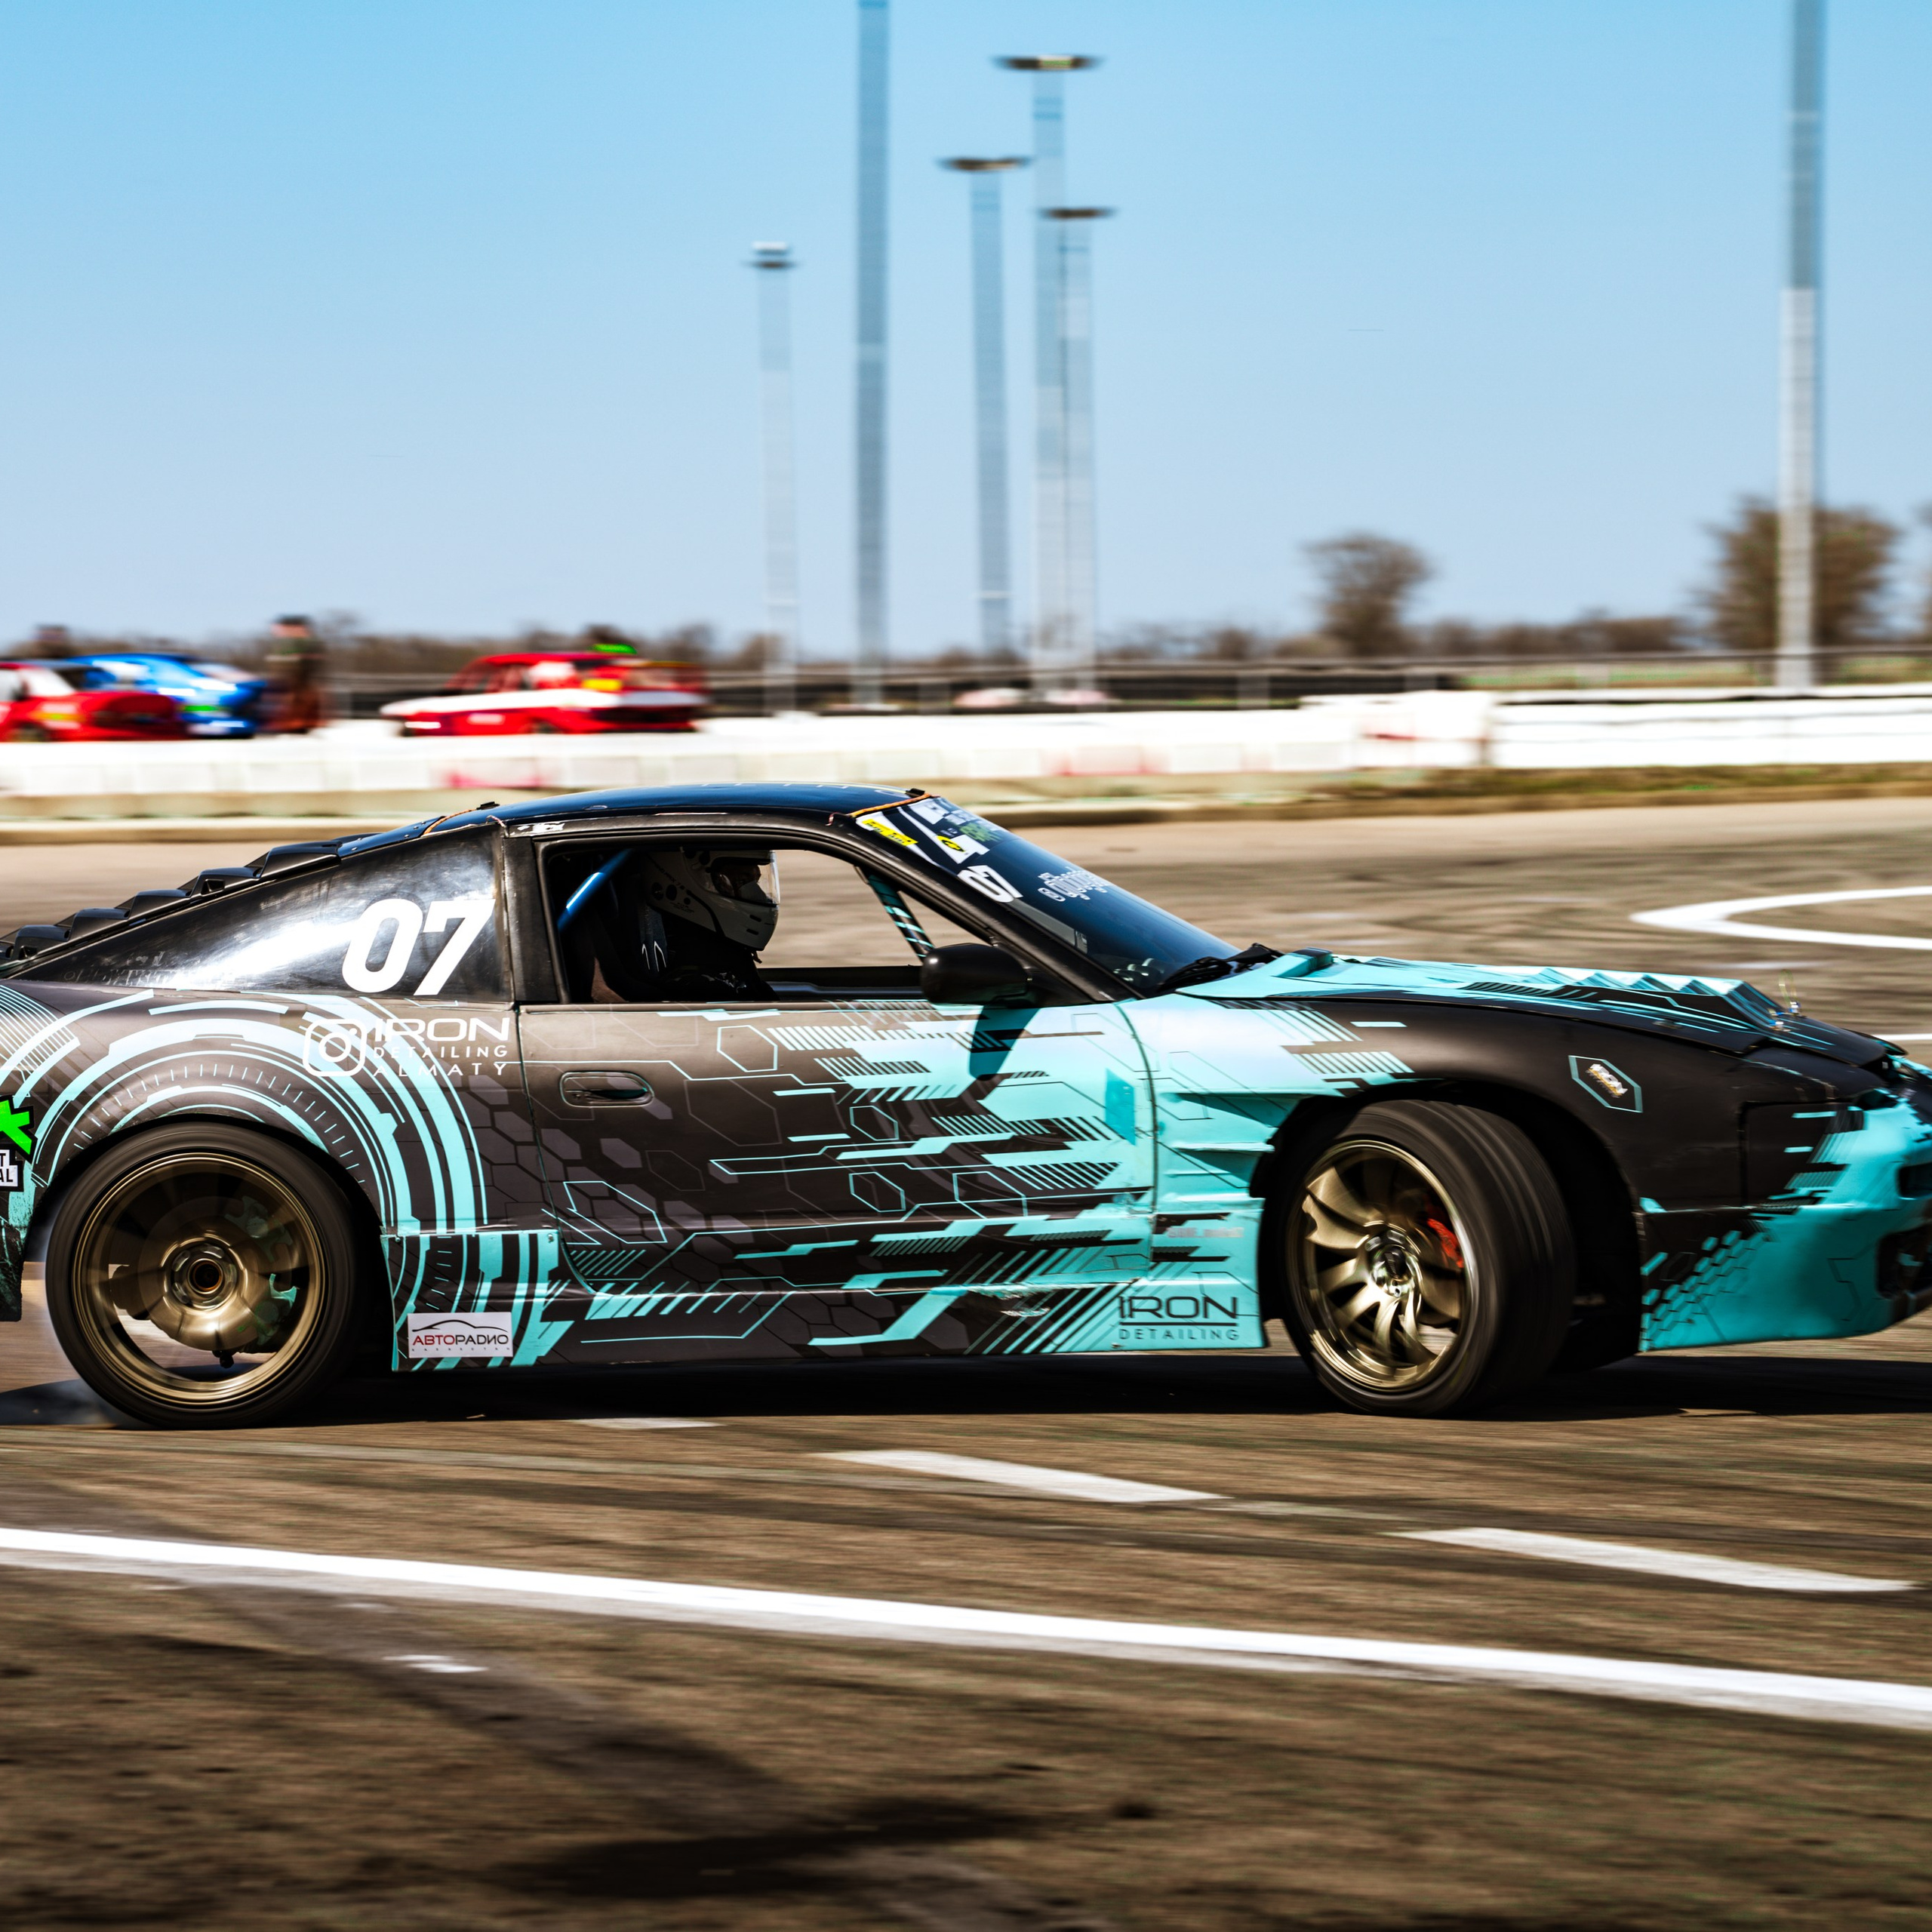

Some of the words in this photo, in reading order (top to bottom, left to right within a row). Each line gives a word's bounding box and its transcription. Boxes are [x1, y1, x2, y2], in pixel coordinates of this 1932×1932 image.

[957, 865, 1023, 903] 07
[342, 898, 496, 995] 07
[374, 1017, 510, 1042] IRON
[374, 1045, 508, 1058] DETAILING
[374, 1063, 506, 1076] ALMATY
[1118, 1296, 1238, 1318] IRON
[1118, 1328, 1239, 1340] DETAILING
